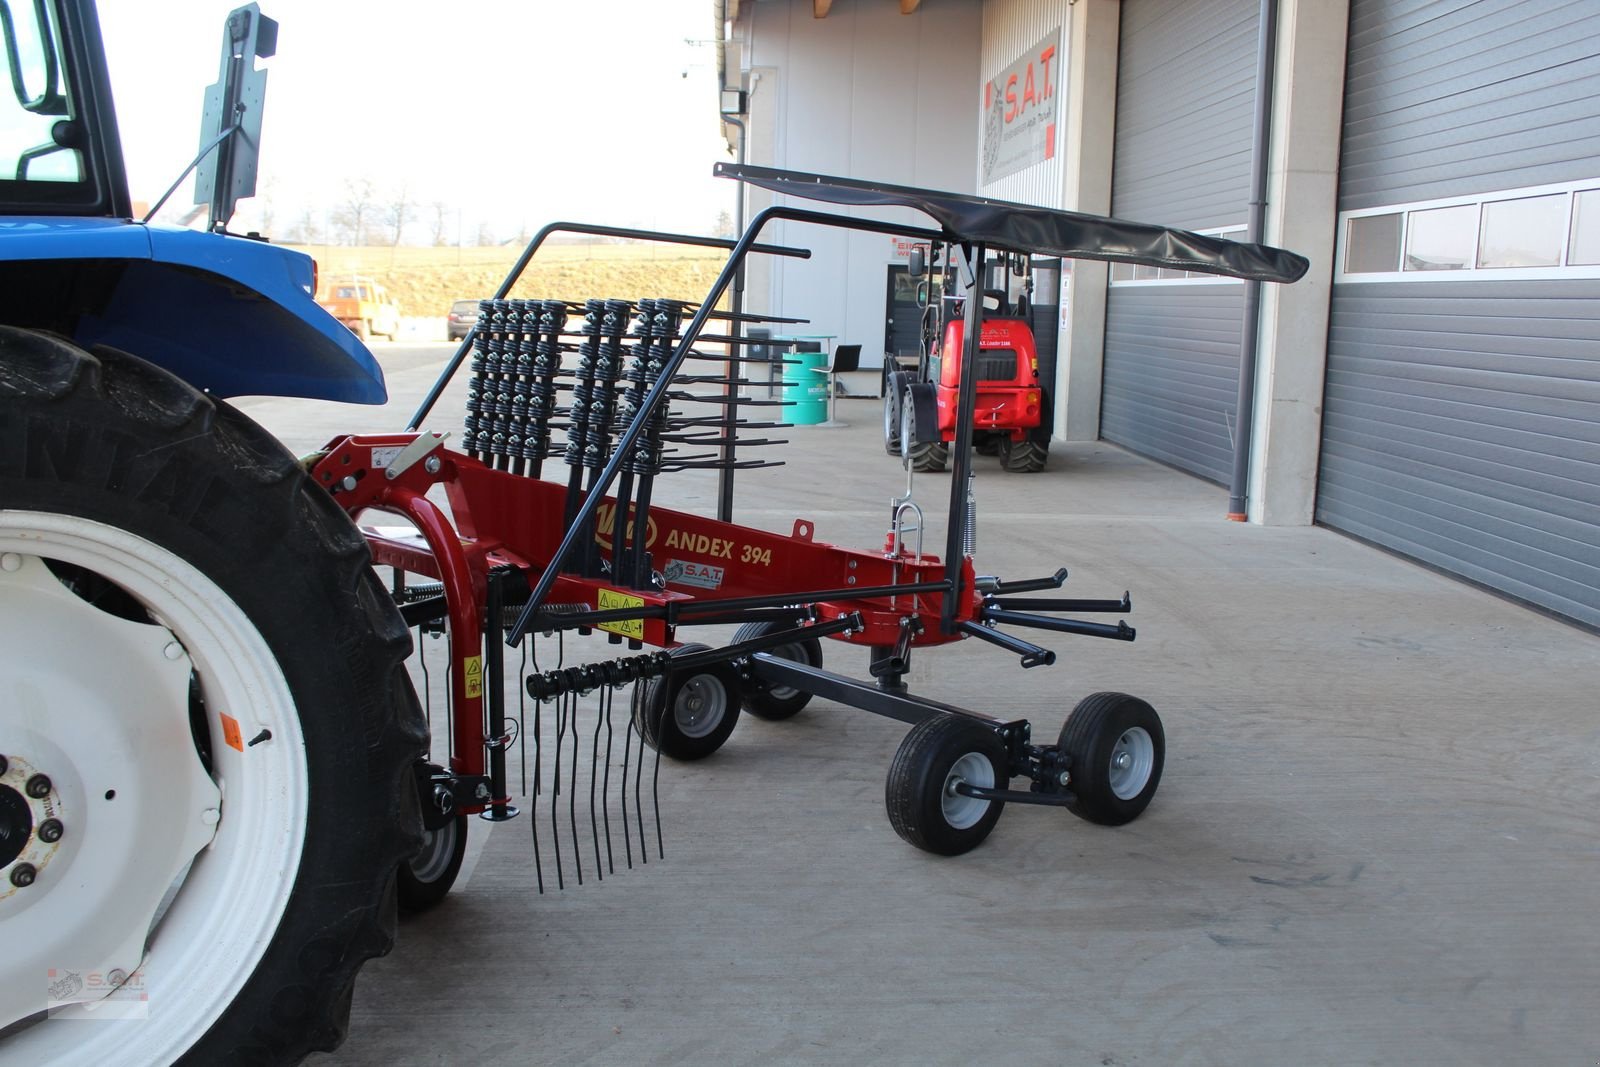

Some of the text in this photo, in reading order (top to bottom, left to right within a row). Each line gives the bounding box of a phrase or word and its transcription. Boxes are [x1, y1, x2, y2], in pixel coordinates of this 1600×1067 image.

[1004, 44, 1056, 125] S.A.T.
[664, 529, 772, 567] ANDEX 394
[684, 564, 722, 580] S.A.T.
